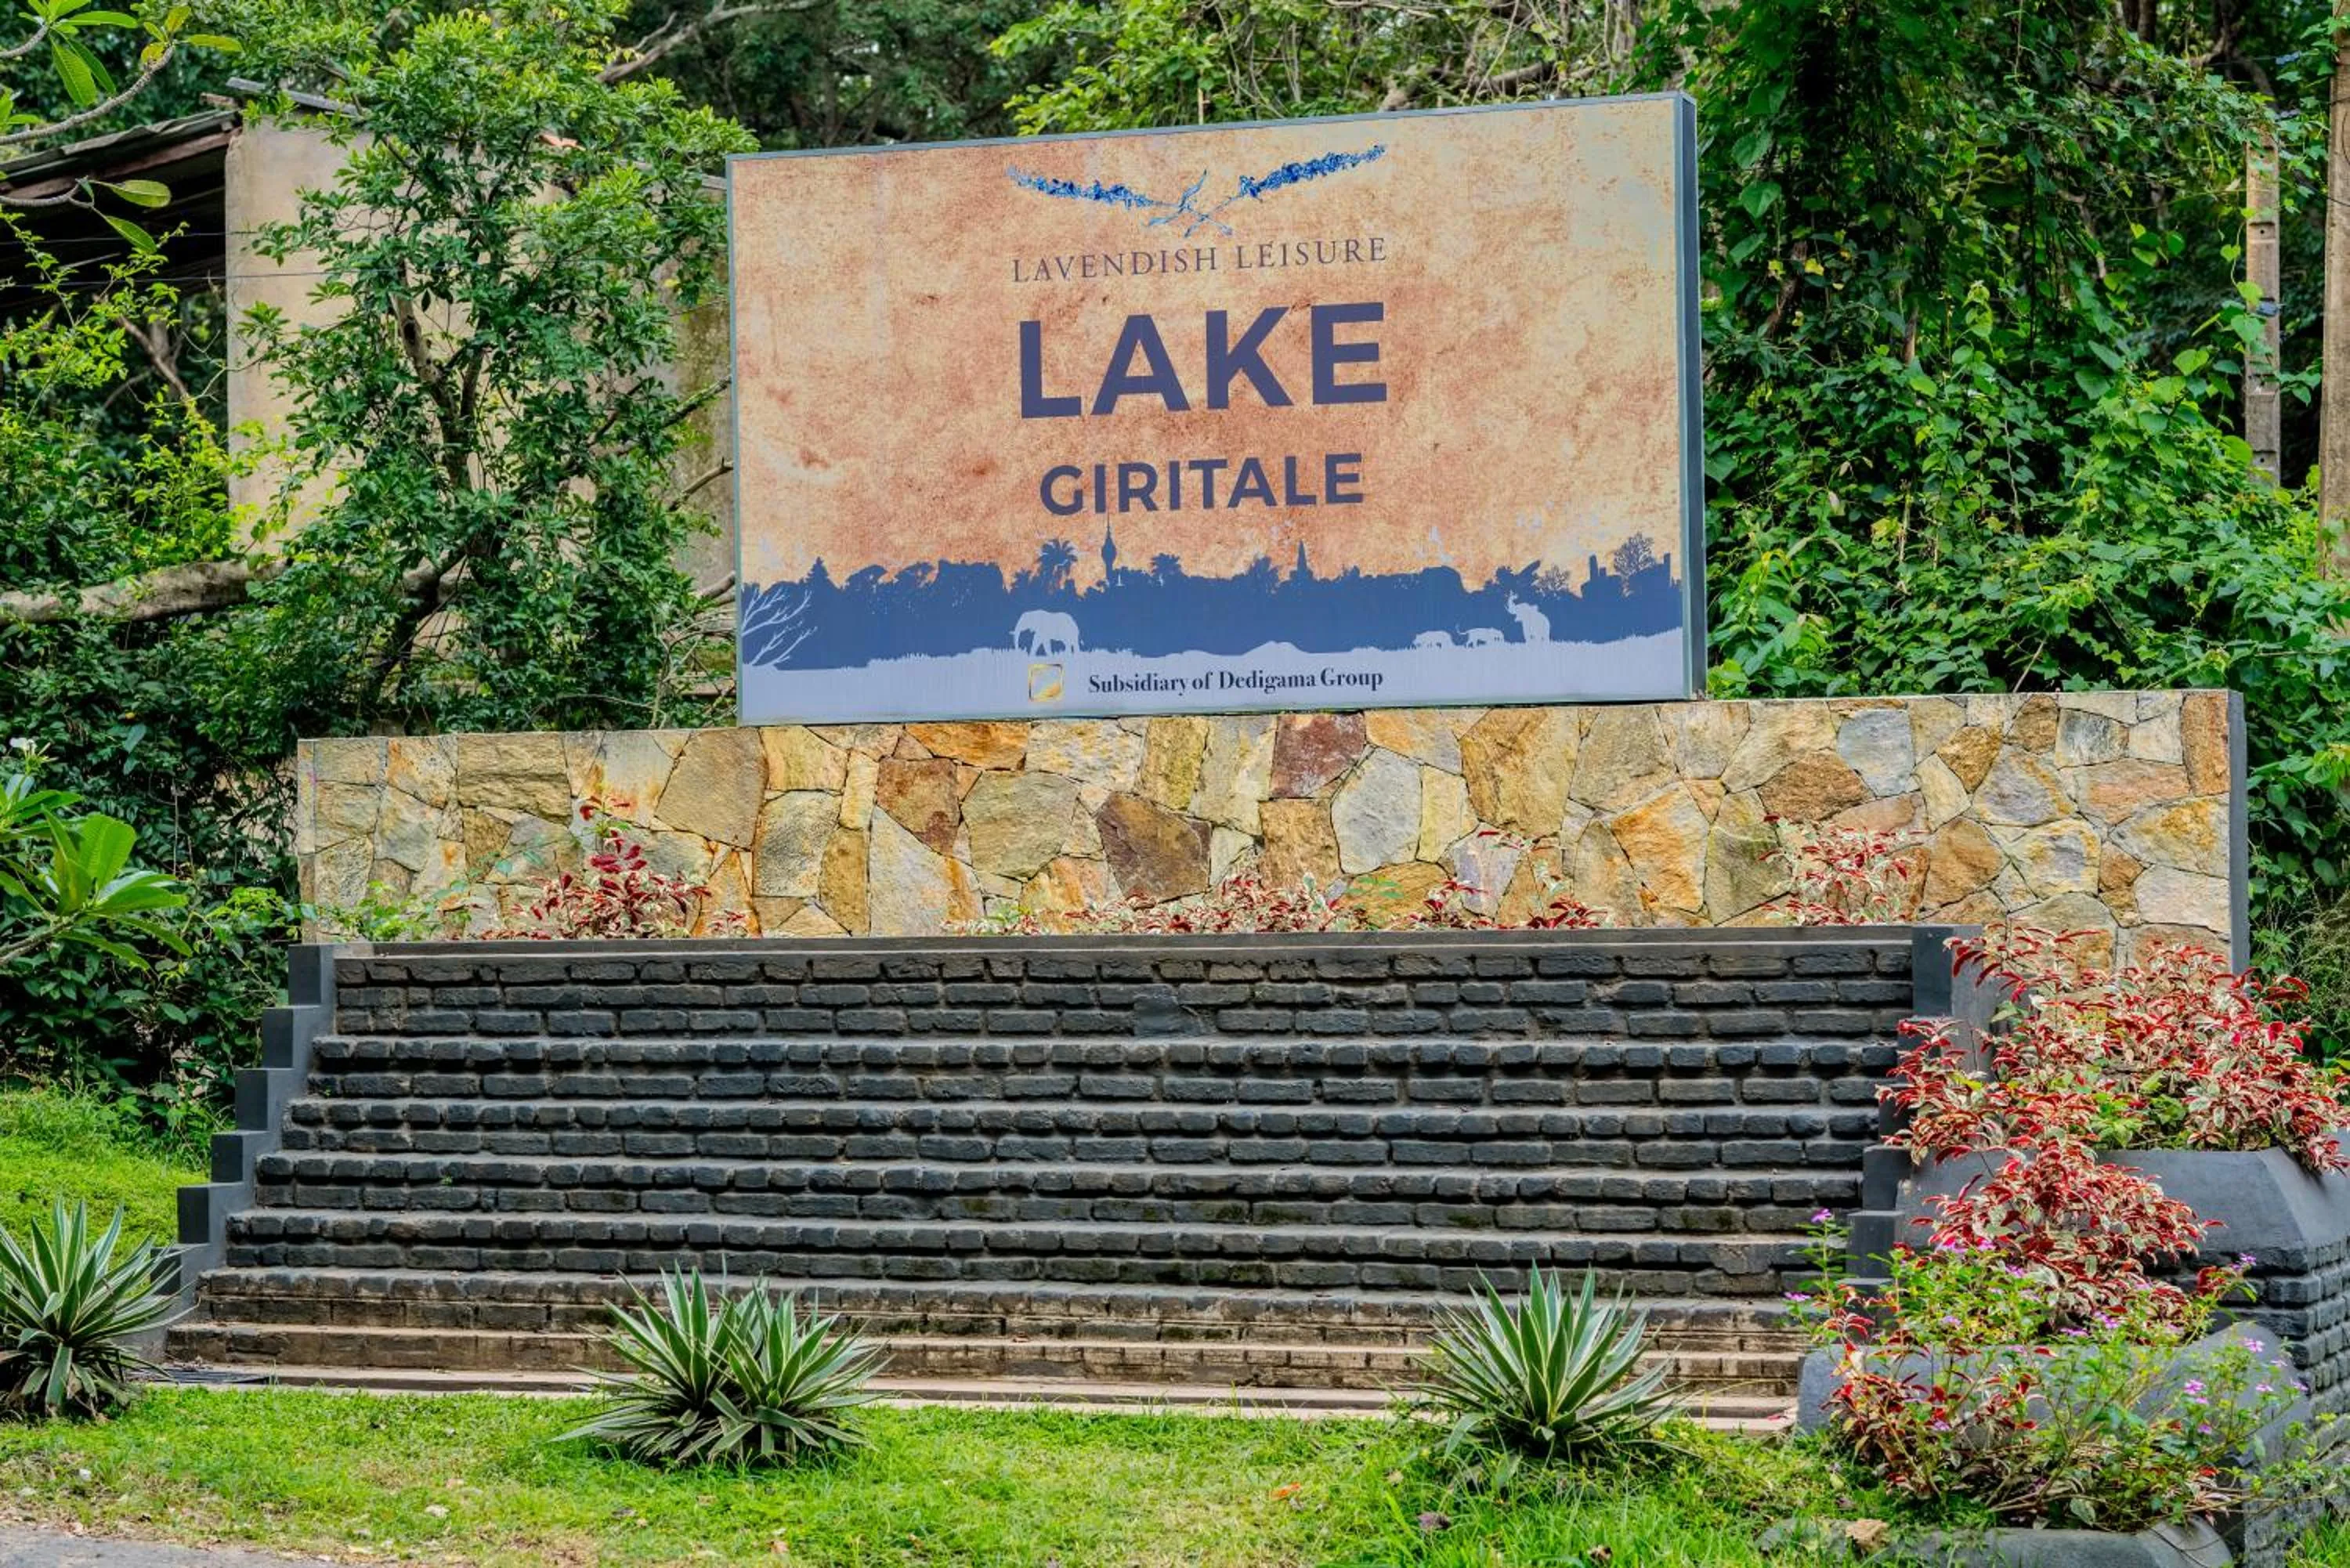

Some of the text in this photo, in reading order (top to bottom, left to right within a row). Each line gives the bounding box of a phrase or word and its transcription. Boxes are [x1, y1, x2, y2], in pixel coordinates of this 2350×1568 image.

[1013, 237, 1388, 283] LAVENDISH LEISURE
[1019, 302, 1387, 418] LAKE
[1039, 453, 1364, 516] GIRITALE
[1088, 667, 1384, 696] Subsidiary of Dedigama Group
